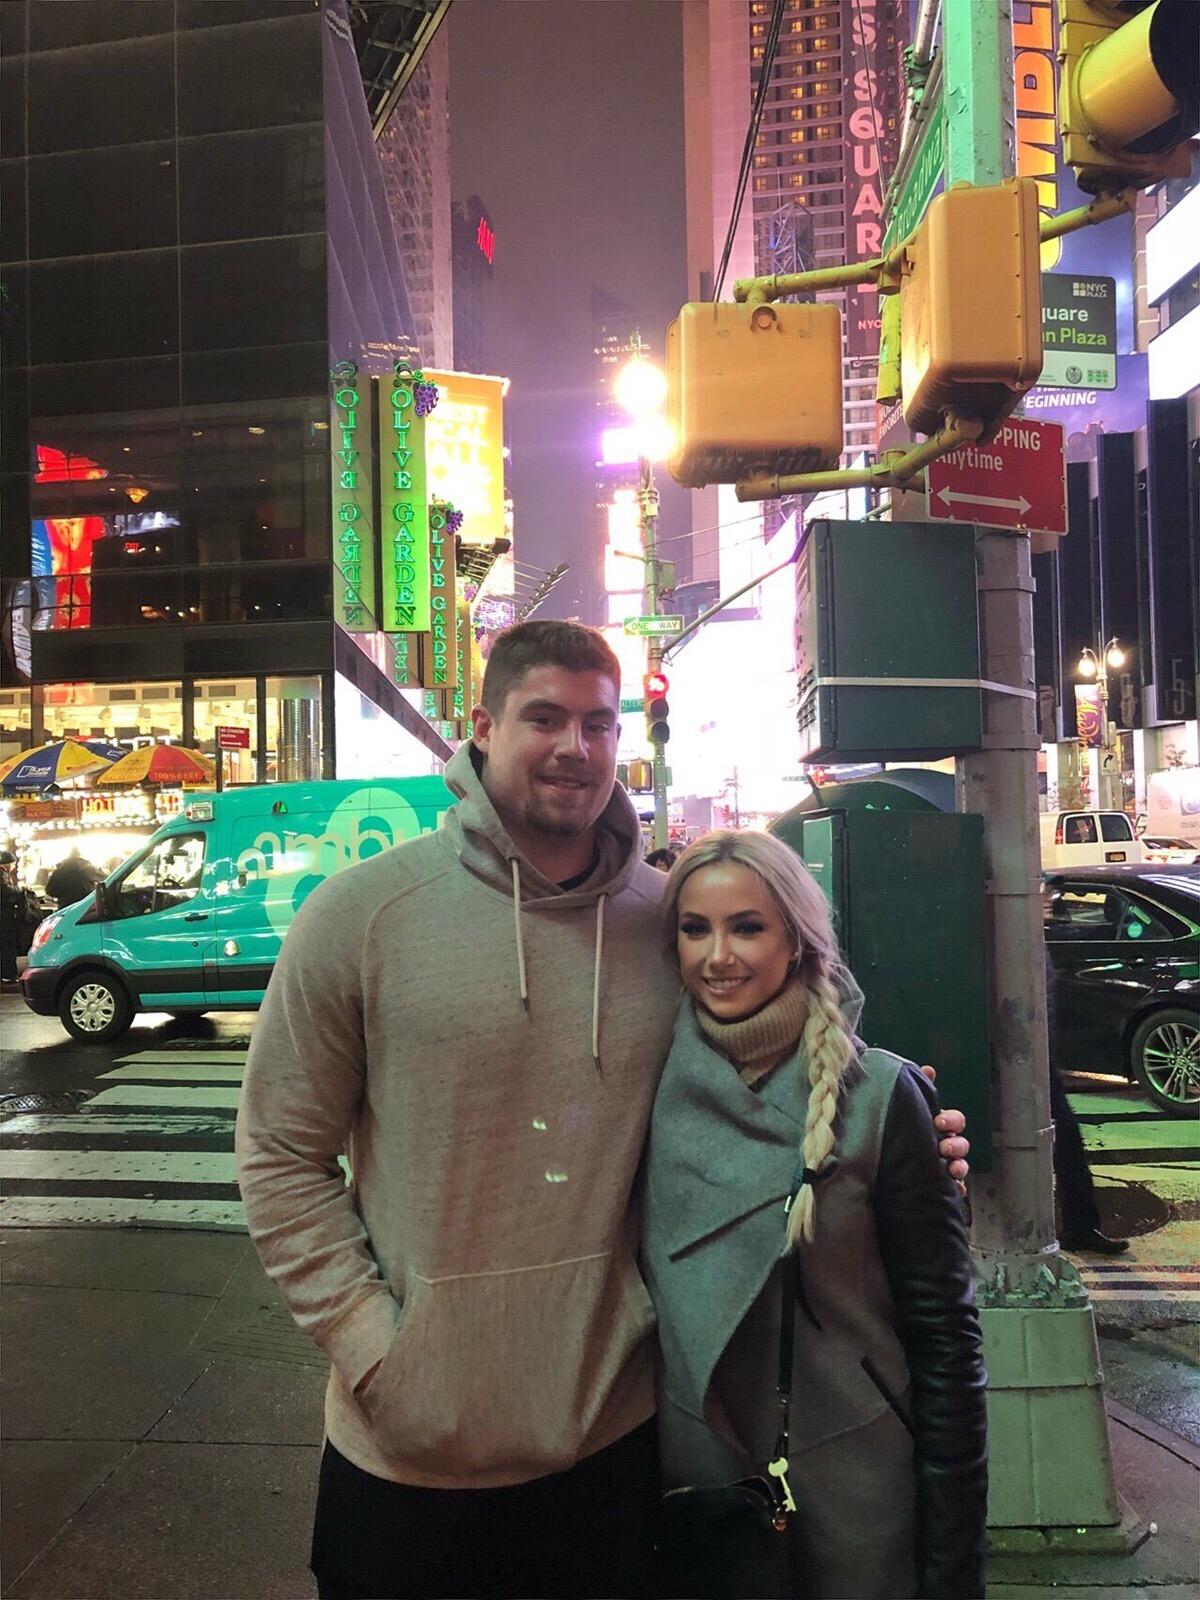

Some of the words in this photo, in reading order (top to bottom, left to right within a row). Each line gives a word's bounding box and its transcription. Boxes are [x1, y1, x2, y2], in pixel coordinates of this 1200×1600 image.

[851, 0, 877, 47] S
[1086, 283, 1108, 294] NYC
[1060, 327, 1107, 346] Plaza
[1023, 391, 1097, 409] EGINNING
[391, 389, 413, 490] OLIVE
[392, 502, 416, 626] GARDEN
[430, 514, 446, 588] OLIVE
[431, 595, 447, 684] GARDEN
[631, 622, 649, 630] ONE
[658, 621, 678, 629] WAY
